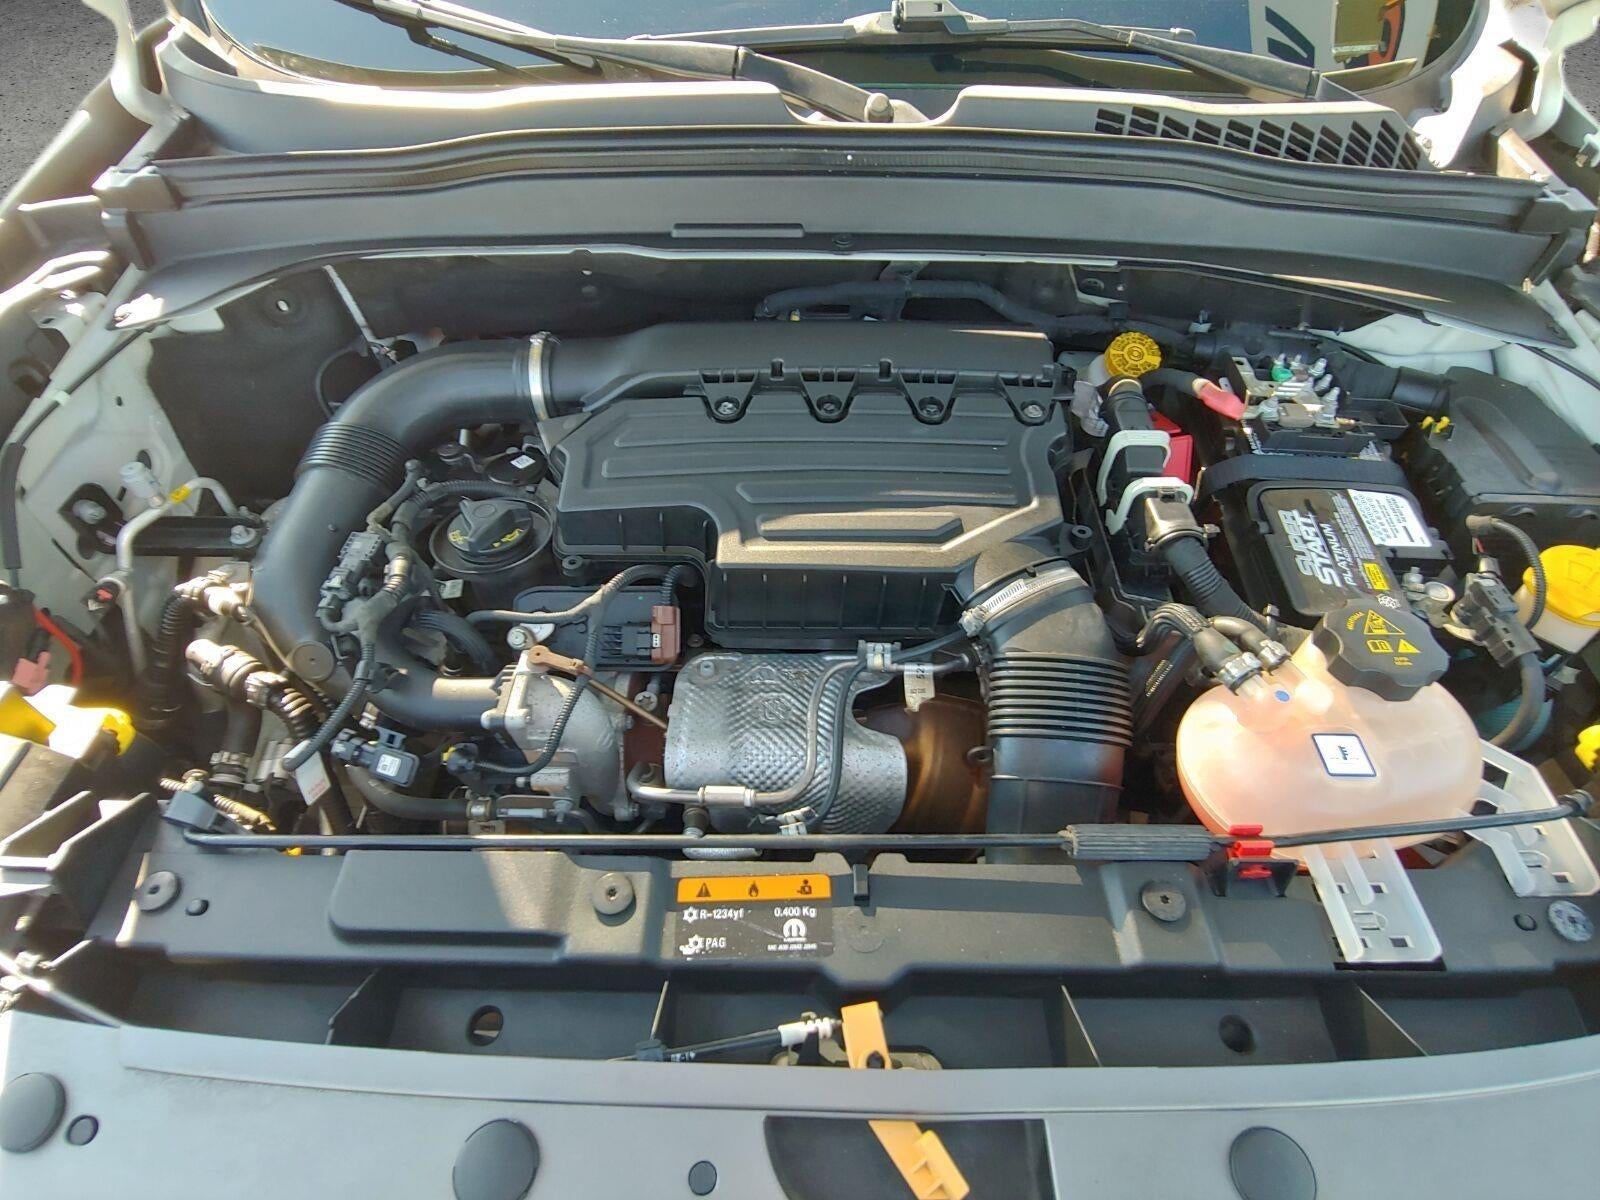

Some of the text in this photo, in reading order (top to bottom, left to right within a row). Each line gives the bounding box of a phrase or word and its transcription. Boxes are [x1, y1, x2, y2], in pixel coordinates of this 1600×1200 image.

[1277, 508, 1315, 576] SUPER
[1291, 508, 1343, 588] START
[1319, 522, 1357, 587] PLATINUM
[699, 906, 745, 921] R-1234yf
[773, 905, 818, 919] 0.400 Kg
[705, 937, 727, 949] PAG
